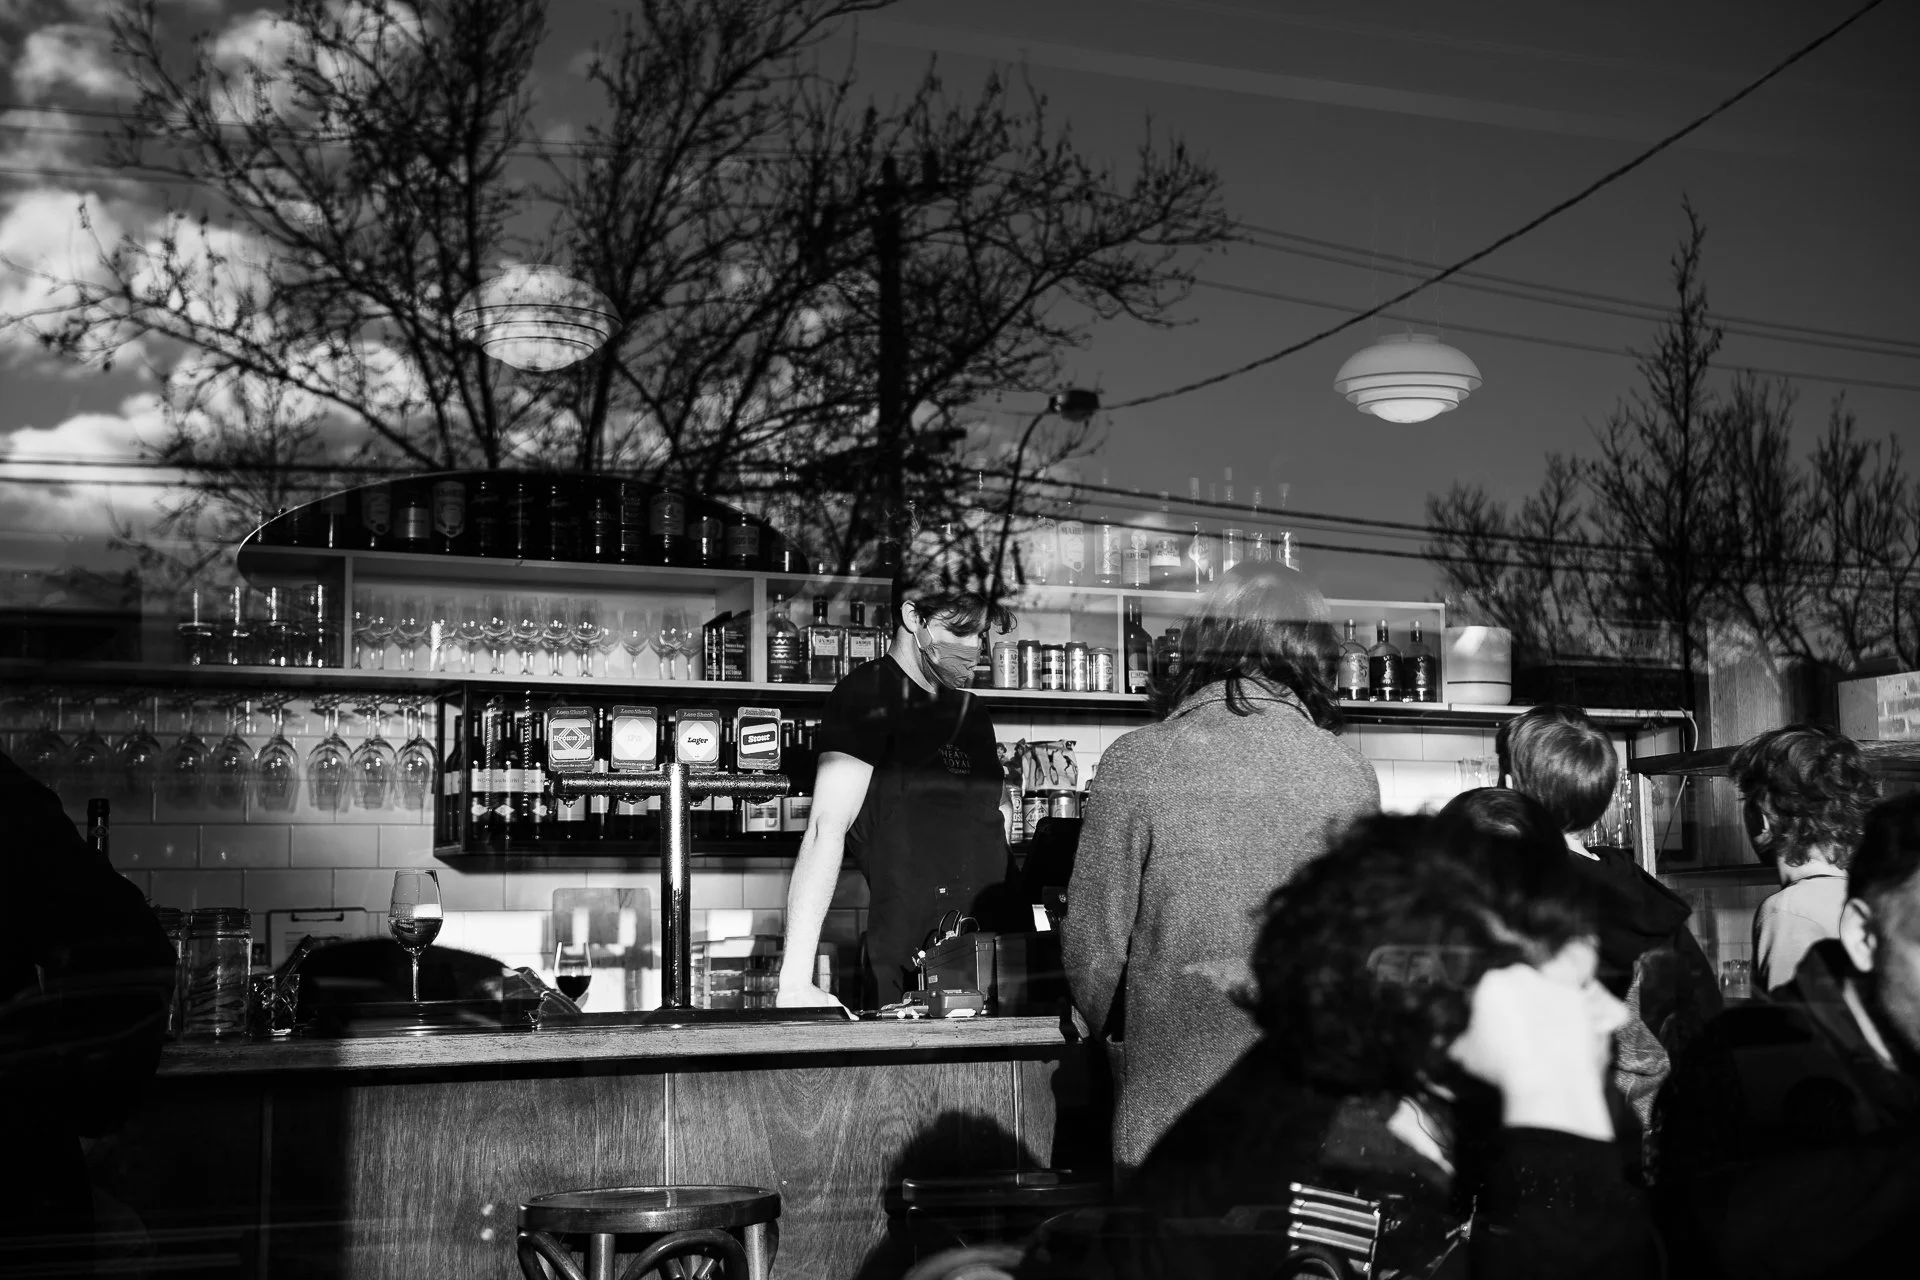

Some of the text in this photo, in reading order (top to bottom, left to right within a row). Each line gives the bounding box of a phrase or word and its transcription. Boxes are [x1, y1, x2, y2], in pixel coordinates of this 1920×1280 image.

[578, 734, 591, 742] Ale
[687, 736, 709, 746] Lager
[747, 733, 771, 743] Stout
